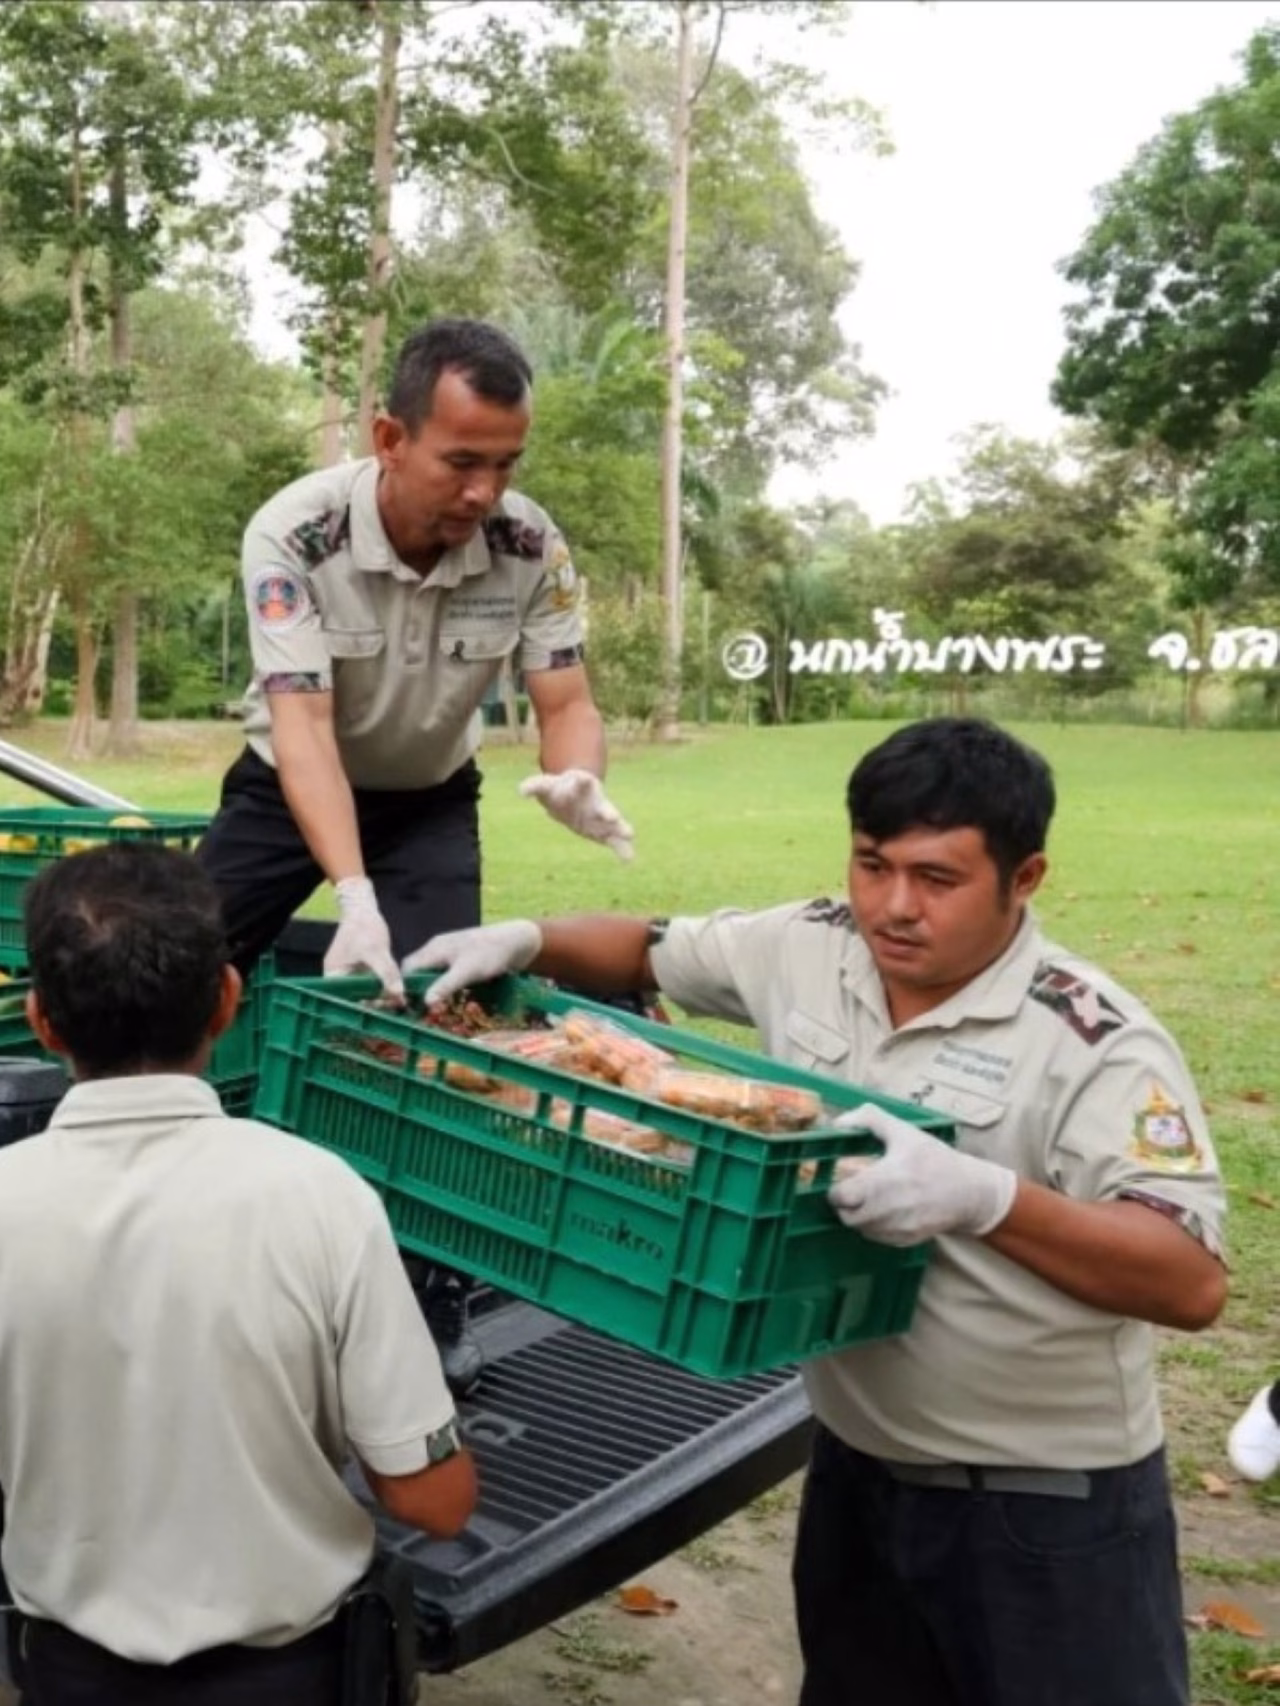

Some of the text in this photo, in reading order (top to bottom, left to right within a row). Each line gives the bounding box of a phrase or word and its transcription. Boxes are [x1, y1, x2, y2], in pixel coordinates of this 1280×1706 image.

[787, 607, 1106, 674] นกน้ำบางพระ
[570, 1212, 664, 1260] makro
